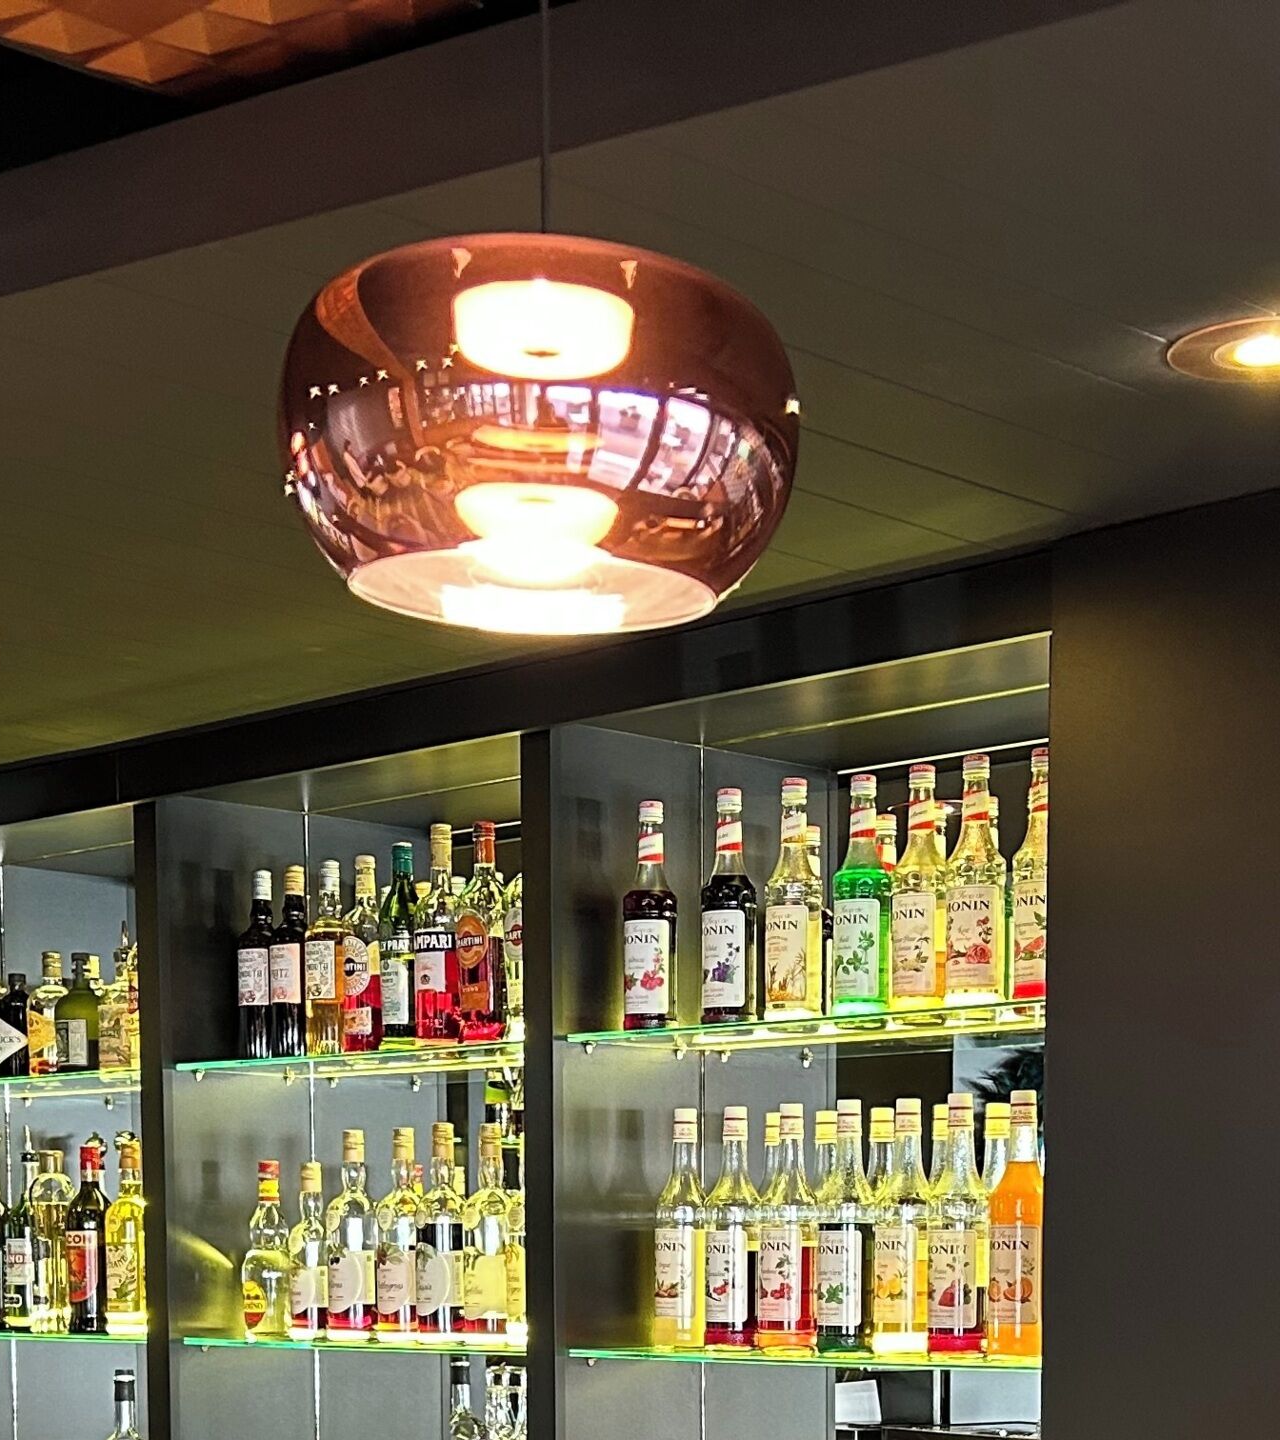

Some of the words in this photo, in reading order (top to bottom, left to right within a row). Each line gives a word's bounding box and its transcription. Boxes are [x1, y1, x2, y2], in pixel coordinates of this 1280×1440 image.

[835, 914, 869, 925] ONIN
[891, 908, 925, 920] ONIN
[702, 924, 735, 936] ONIN
[766, 920, 799, 931] ONIN
[624, 934, 660, 945] ONIN
[656, 1242, 686, 1251] ONIN
[707, 1244, 735, 1254] ONIN
[761, 1241, 791, 1251] ONIN
[819, 1245, 849, 1256] ONIN
[875, 1240, 906, 1251] ONIN
[929, 1244, 967, 1255] ONIN
[991, 1240, 1030, 1250] ONIN
